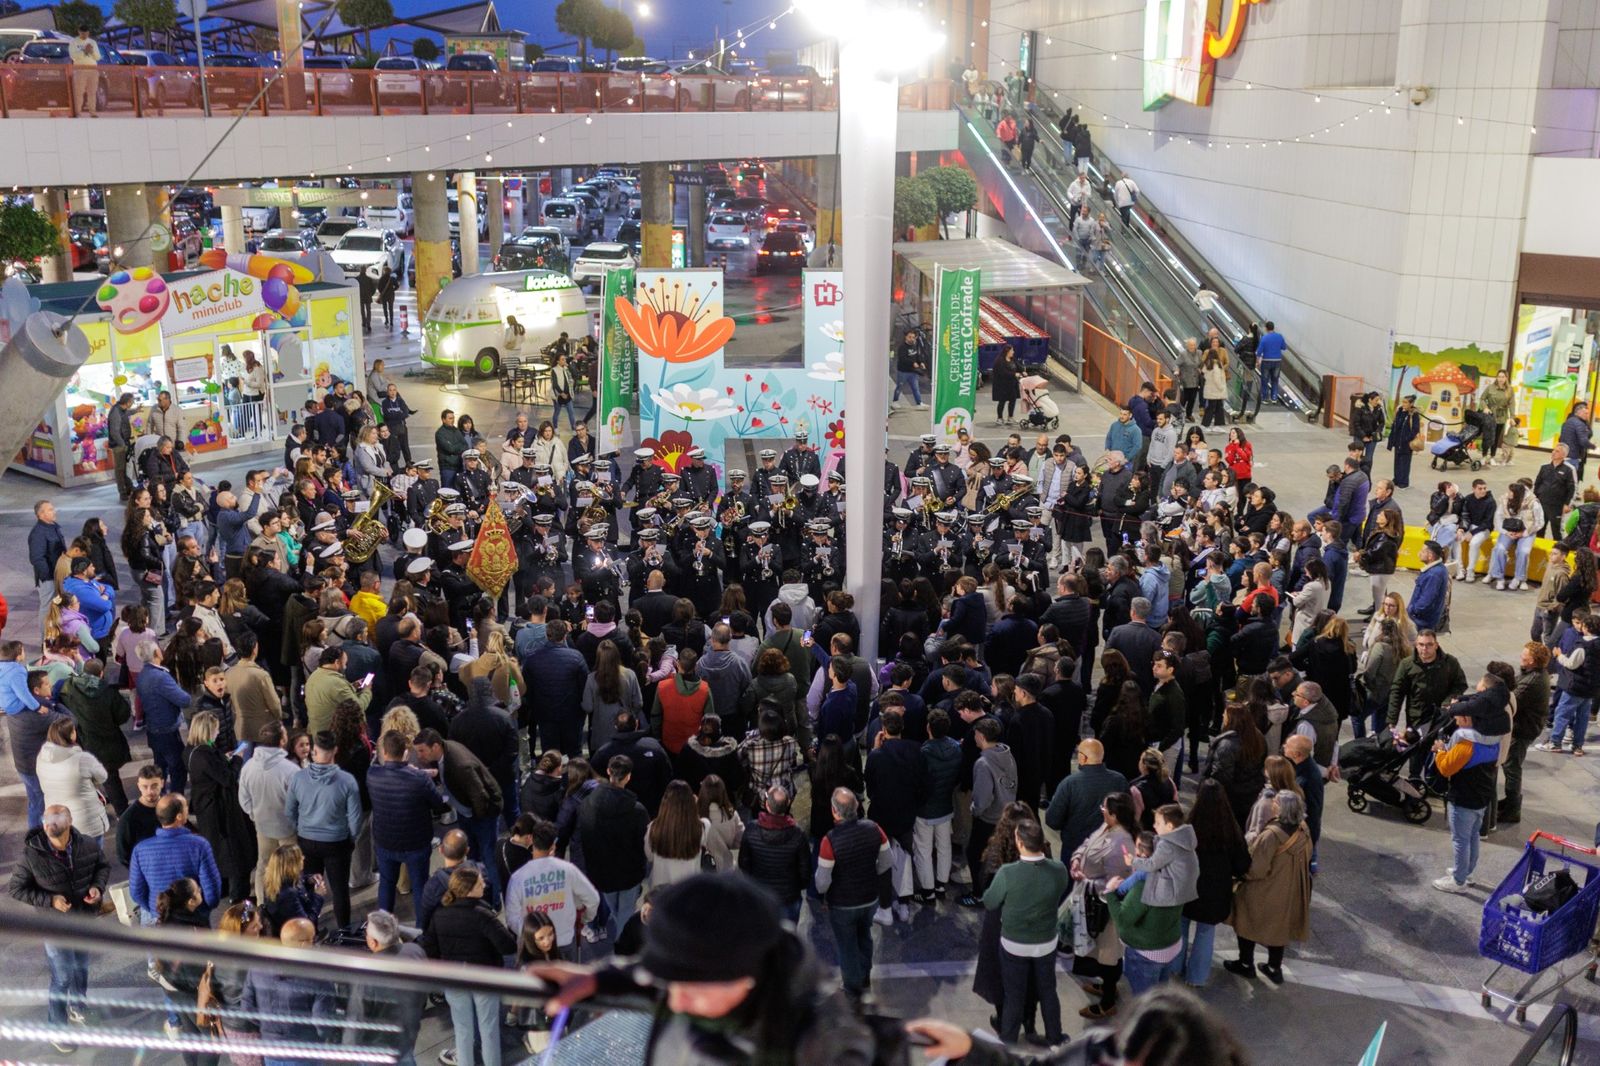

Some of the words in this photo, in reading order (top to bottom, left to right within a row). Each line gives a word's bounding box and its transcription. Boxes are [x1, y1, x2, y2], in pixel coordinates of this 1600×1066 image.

[172, 272, 254, 314] hache
[191, 298, 243, 320] miniclub
[950, 292, 961, 310] DE
[959, 275, 974, 338] Cofrade
[619, 340, 632, 396] Música
[949, 313, 961, 383] CERTAMEN
[958, 340, 974, 397] Música
